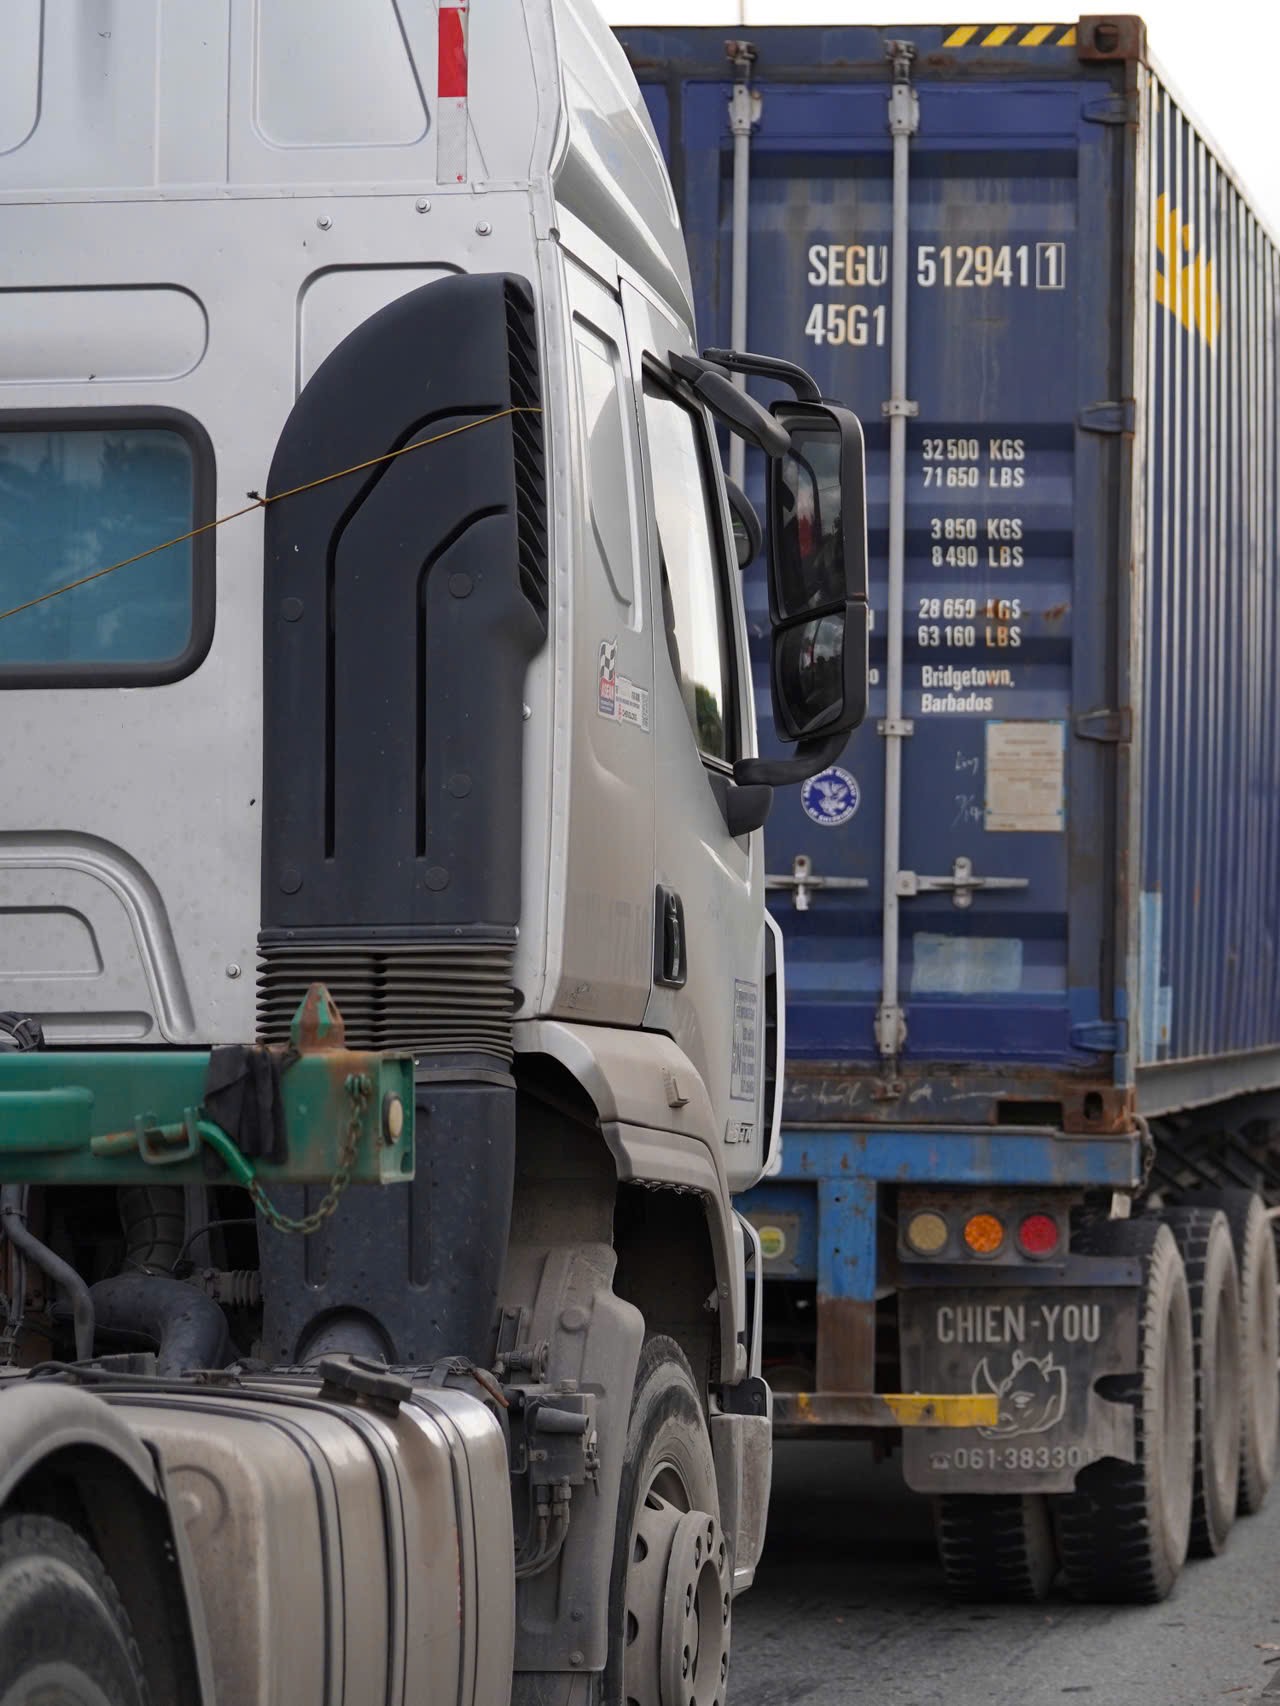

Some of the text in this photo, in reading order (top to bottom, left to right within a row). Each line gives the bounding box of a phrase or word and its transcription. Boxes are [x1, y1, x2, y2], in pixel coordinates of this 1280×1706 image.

[808, 244, 887, 287] SEGU
[917, 245, 1028, 287] 512941
[805, 303, 885, 346] 45G1
[990, 439, 1025, 461] KGS
[988, 466, 1025, 488] LBS
[987, 518, 1023, 540] KGS
[988, 546, 1024, 568] LBS
[986, 598, 1021, 619] KGS
[985, 625, 1022, 647] LBS
[921, 665, 1015, 691] Bridgetown,
[921, 693, 993, 713] Barbados
[937, 1304, 1101, 1344] CHIEN-YOU
